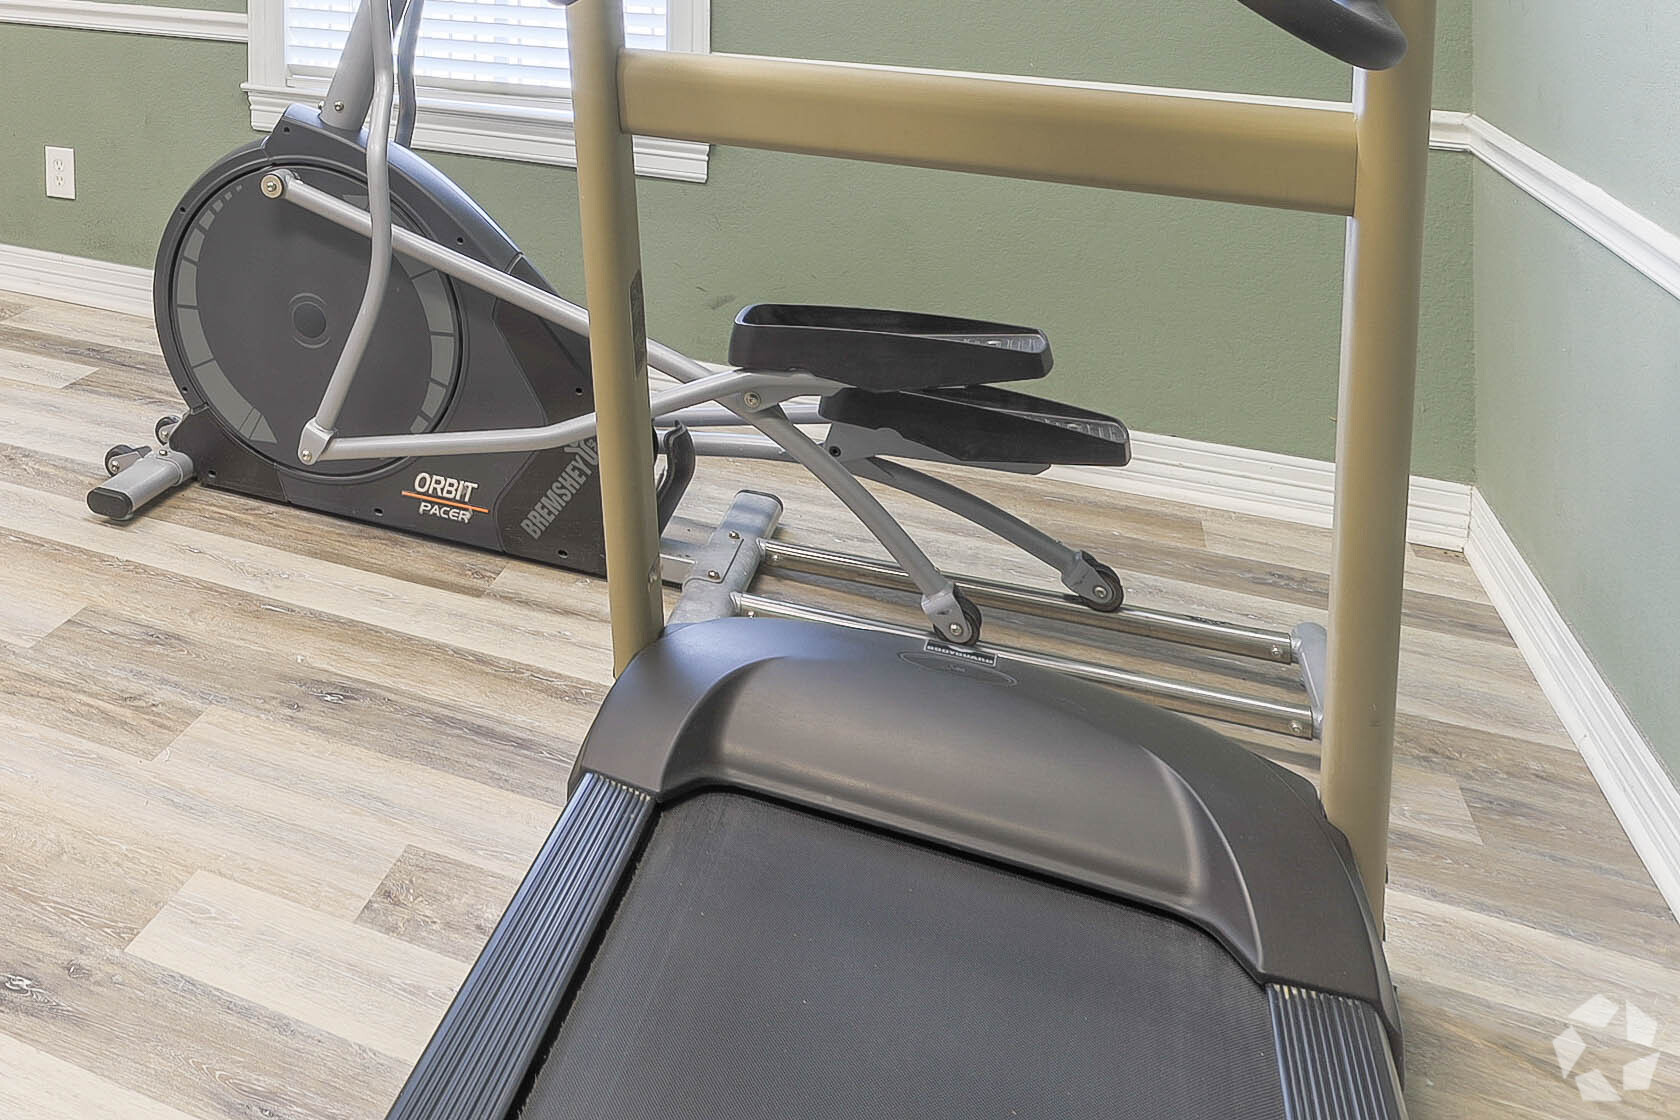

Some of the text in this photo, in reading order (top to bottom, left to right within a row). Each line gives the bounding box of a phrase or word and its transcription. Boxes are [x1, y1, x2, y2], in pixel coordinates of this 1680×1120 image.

[414, 472, 479, 502] ORBIT
[520, 453, 592, 540] BREMSHEY
[419, 501, 474, 524] PACER
